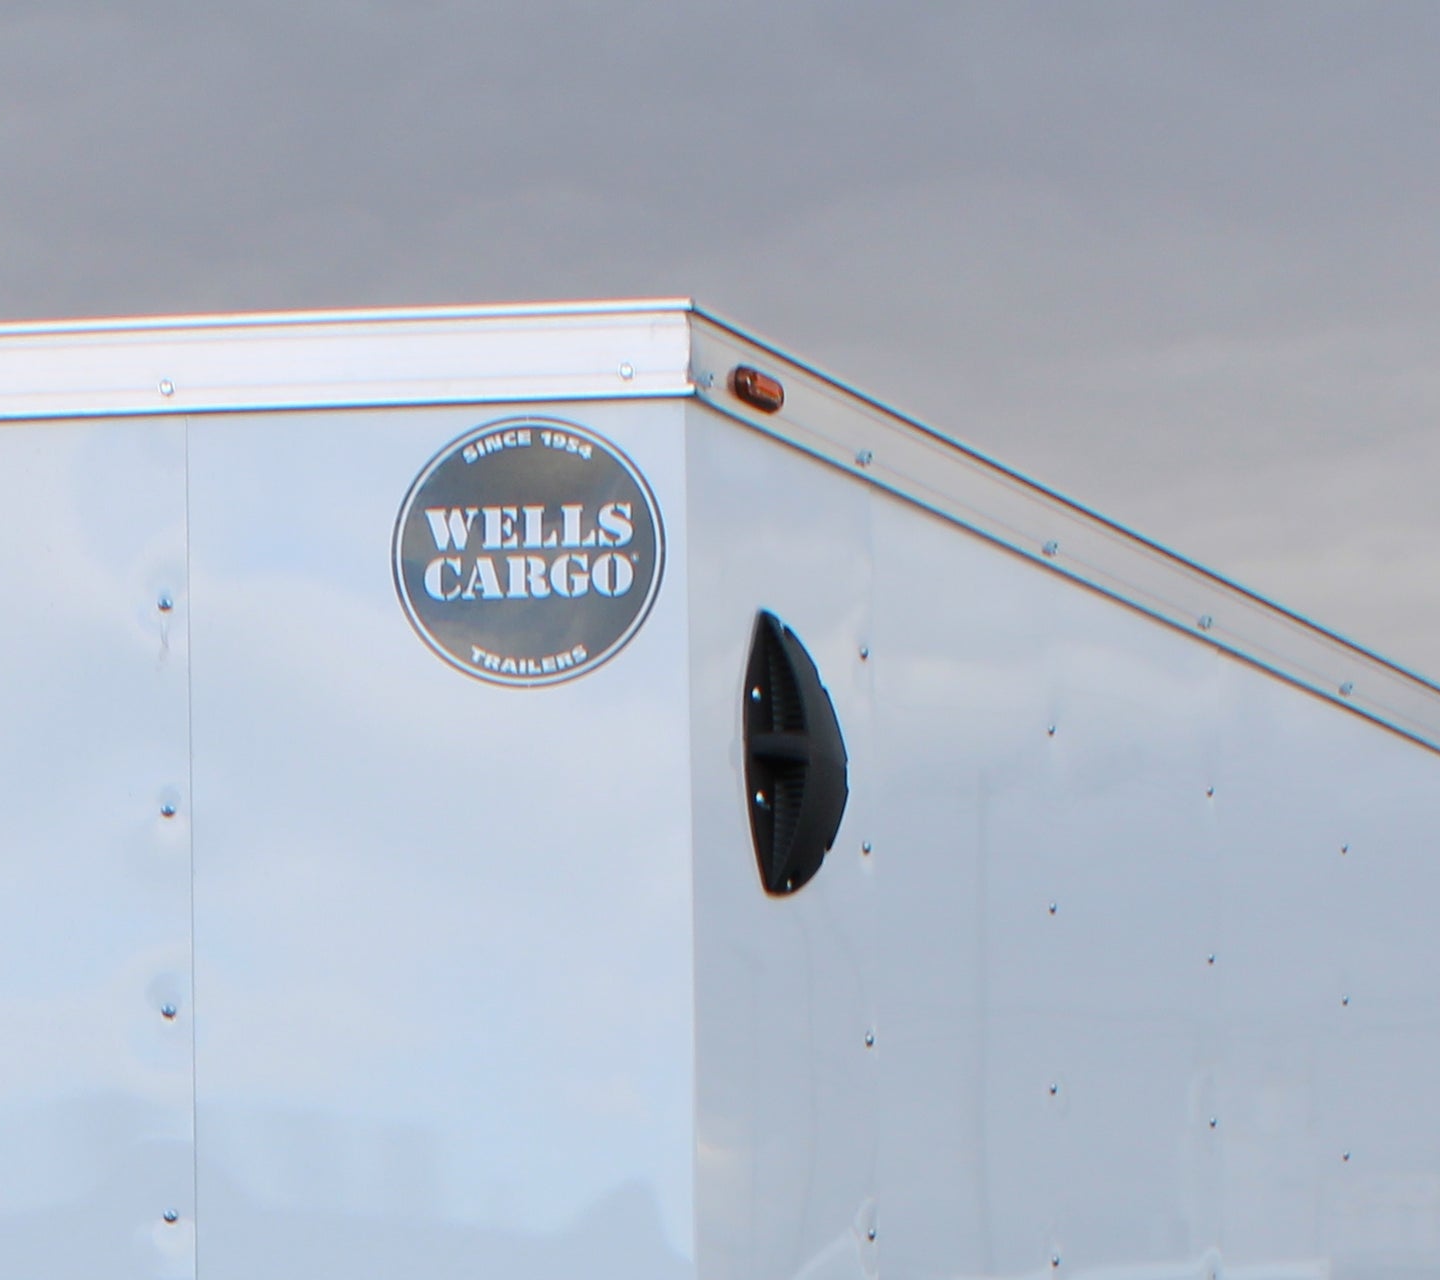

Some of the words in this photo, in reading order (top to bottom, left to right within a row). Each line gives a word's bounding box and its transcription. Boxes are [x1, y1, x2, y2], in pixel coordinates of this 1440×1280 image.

[462, 429, 532, 464] SINCE
[540, 430, 594, 460] 1954
[424, 502, 634, 551] WELLS
[423, 553, 635, 601] CARGO
[471, 644, 588, 675] TRAILERS
